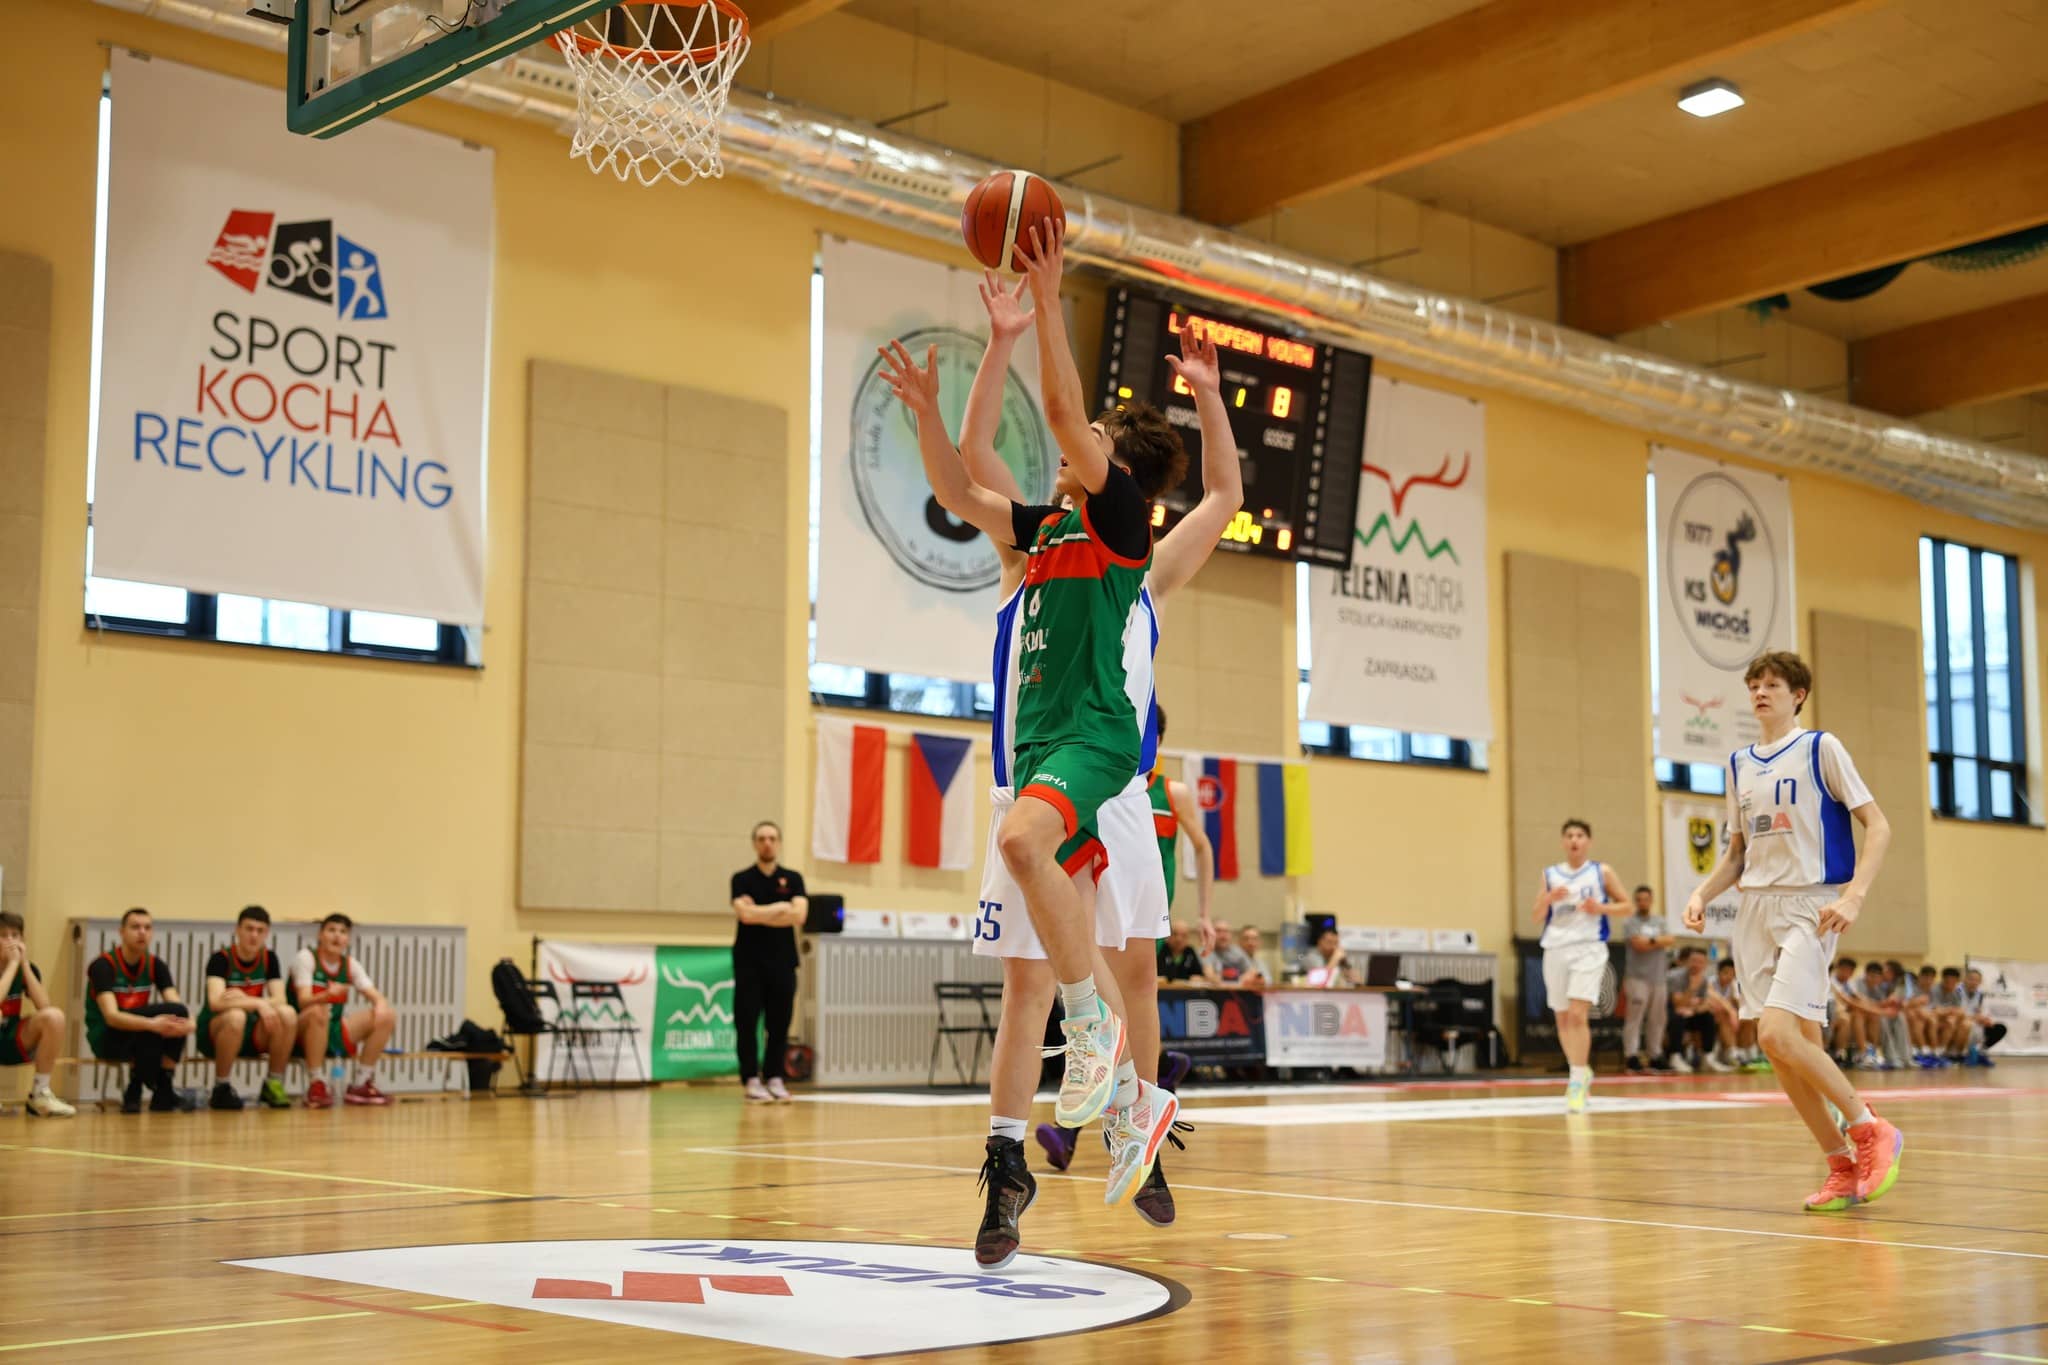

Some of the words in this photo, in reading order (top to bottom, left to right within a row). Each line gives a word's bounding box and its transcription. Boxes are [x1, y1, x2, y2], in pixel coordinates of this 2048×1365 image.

[210, 310, 396, 389] SPORT
[197, 364, 402, 448] KOCHA
[1271, 386, 1291, 418] 8
[135, 411, 453, 509] RECYKLING
[1775, 778, 1797, 805] 17
[1159, 999, 1249, 1039] NBA
[1280, 1000, 1369, 1038] NBA
[633, 1244, 1106, 1299] SUZUKI
